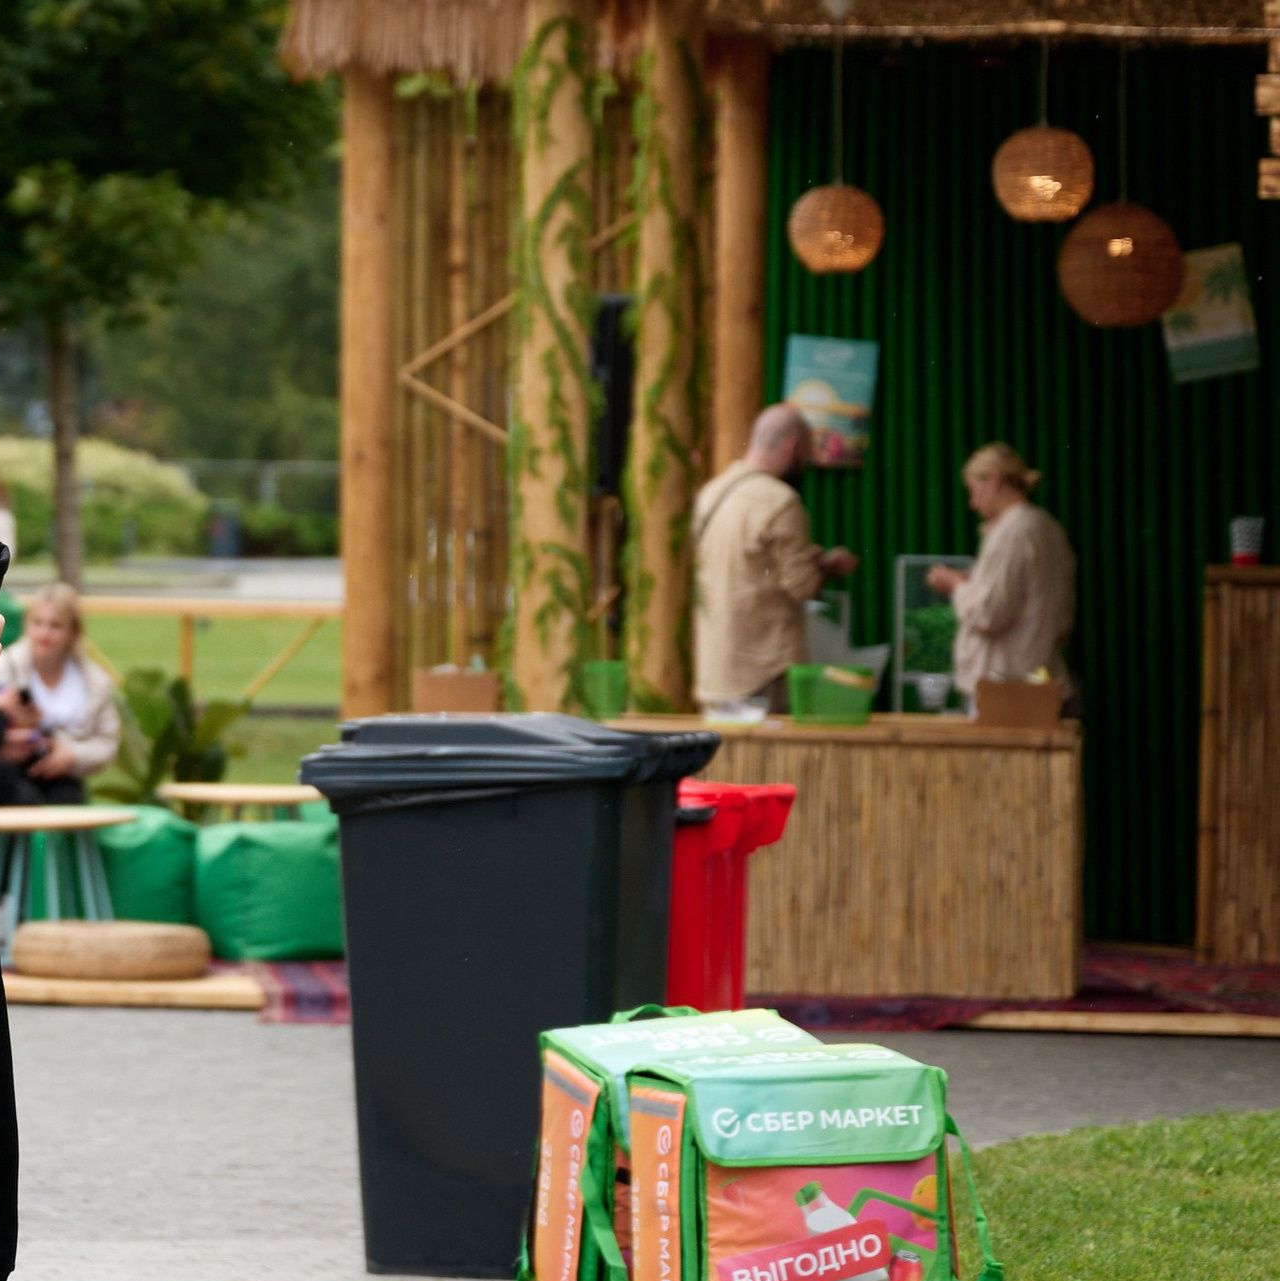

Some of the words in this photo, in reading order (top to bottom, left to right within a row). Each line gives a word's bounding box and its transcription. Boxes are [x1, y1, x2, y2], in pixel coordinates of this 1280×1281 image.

[746, 1110, 814, 1132] СБЕР
[821, 1104, 923, 1129] МАРКЕТ
[567, 1144, 581, 1213] СБЕР
[655, 1162, 671, 1232] СБЕР
